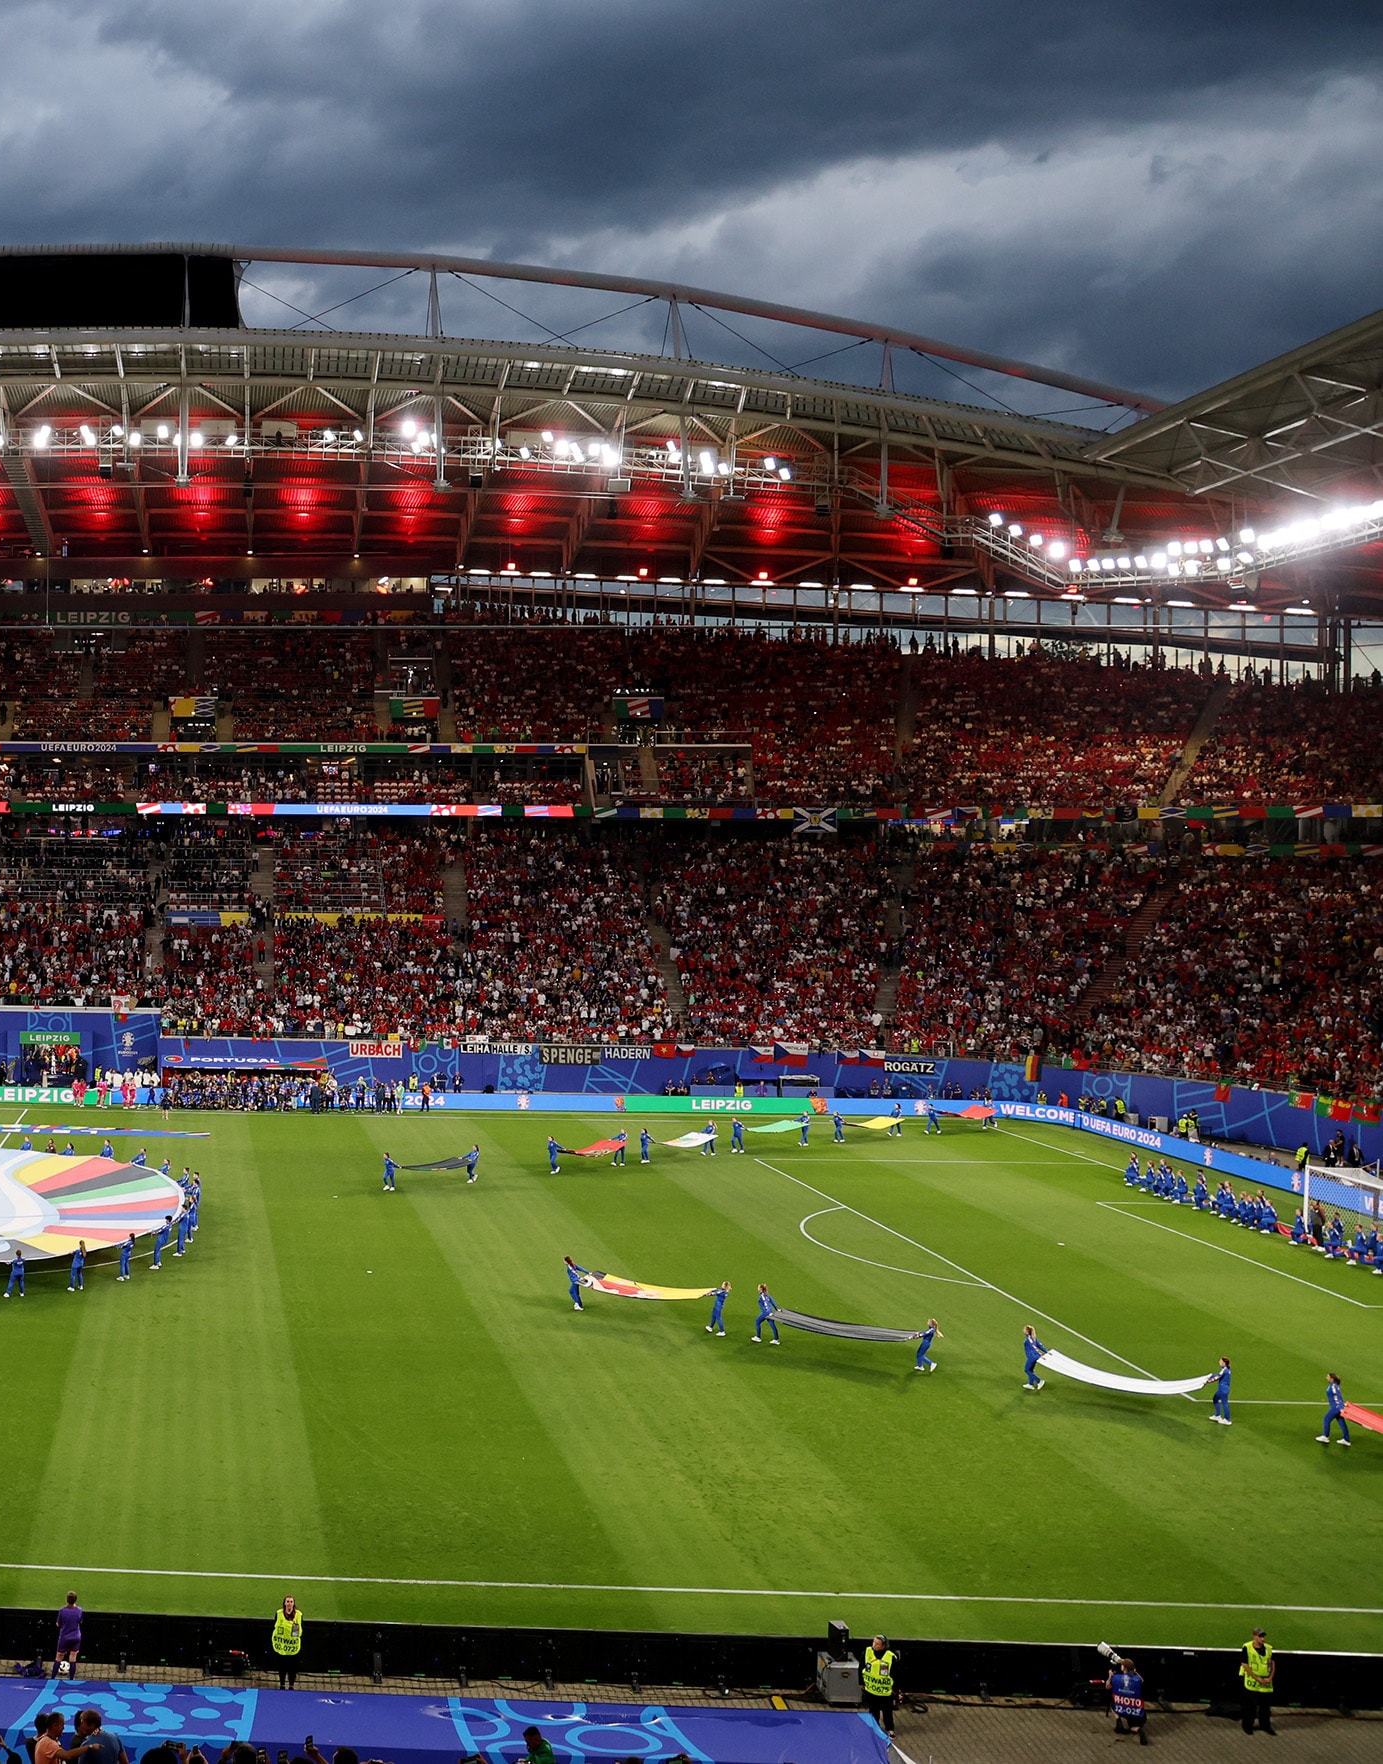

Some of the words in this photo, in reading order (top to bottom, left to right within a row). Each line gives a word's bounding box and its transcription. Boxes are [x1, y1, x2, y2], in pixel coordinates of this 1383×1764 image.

[57, 611, 131, 623] LEIPZIG
[320, 744, 367, 753] LEIPZIG
[52, 803, 95, 812] LEIPZIG
[29, 1034, 71, 1042] LEIPZIG
[350, 1042, 402, 1057] URBACH
[460, 1044, 490, 1054] LEIHA
[604, 1047, 651, 1060] HADERN
[190, 1056, 280, 1064] PORTUGAL
[542, 1047, 592, 1064] SPENGE
[692, 1099, 753, 1111] LEIPZIG
[1000, 1104, 1075, 1123] WELCOME
[1090, 1118, 1112, 1134] UEFA
[1113, 1125, 1137, 1141] EURO
[1137, 1131, 1162, 1148] 2024
[1114, 1695, 1142, 1707] PHOTO
